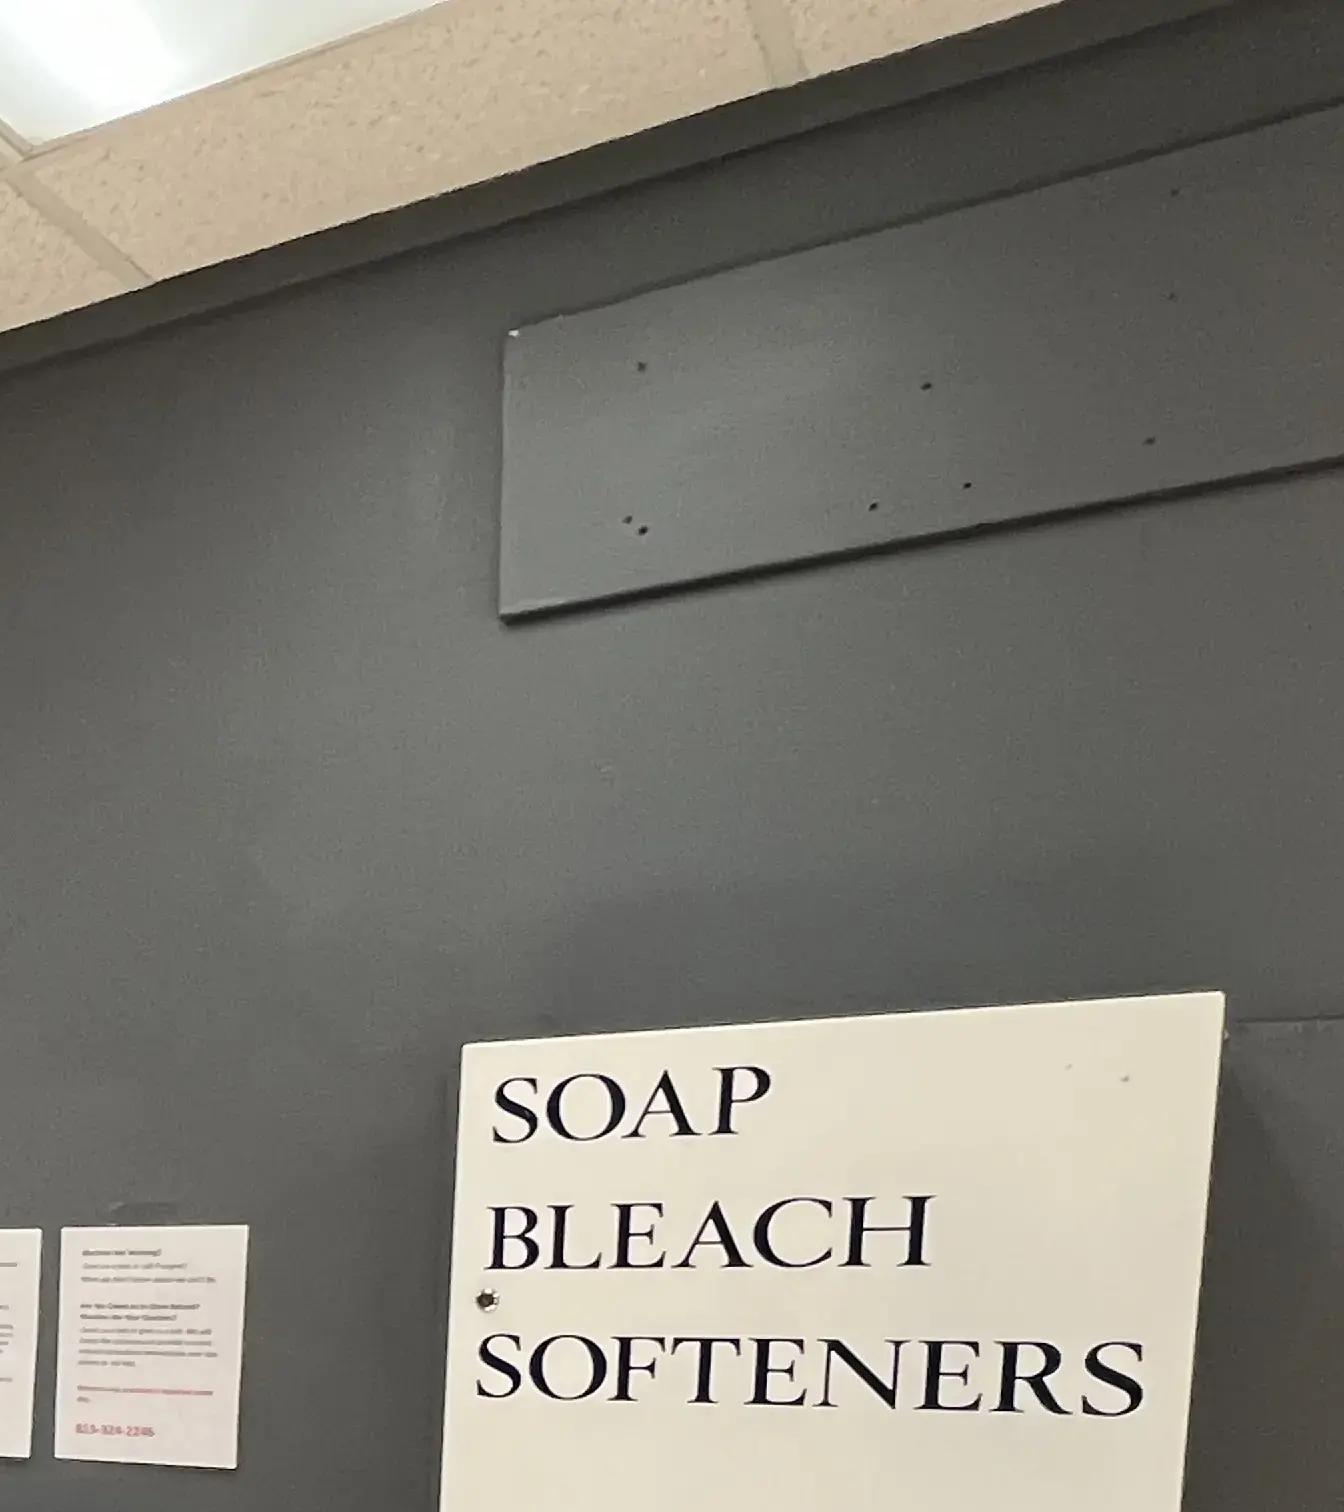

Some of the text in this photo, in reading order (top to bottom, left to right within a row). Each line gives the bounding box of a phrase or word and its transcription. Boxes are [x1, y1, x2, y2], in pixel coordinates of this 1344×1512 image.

[492, 1065, 772, 1144] SOAP
[484, 1194, 935, 1271] BLEACH
[475, 1332, 1144, 1418] SOFTENERS
